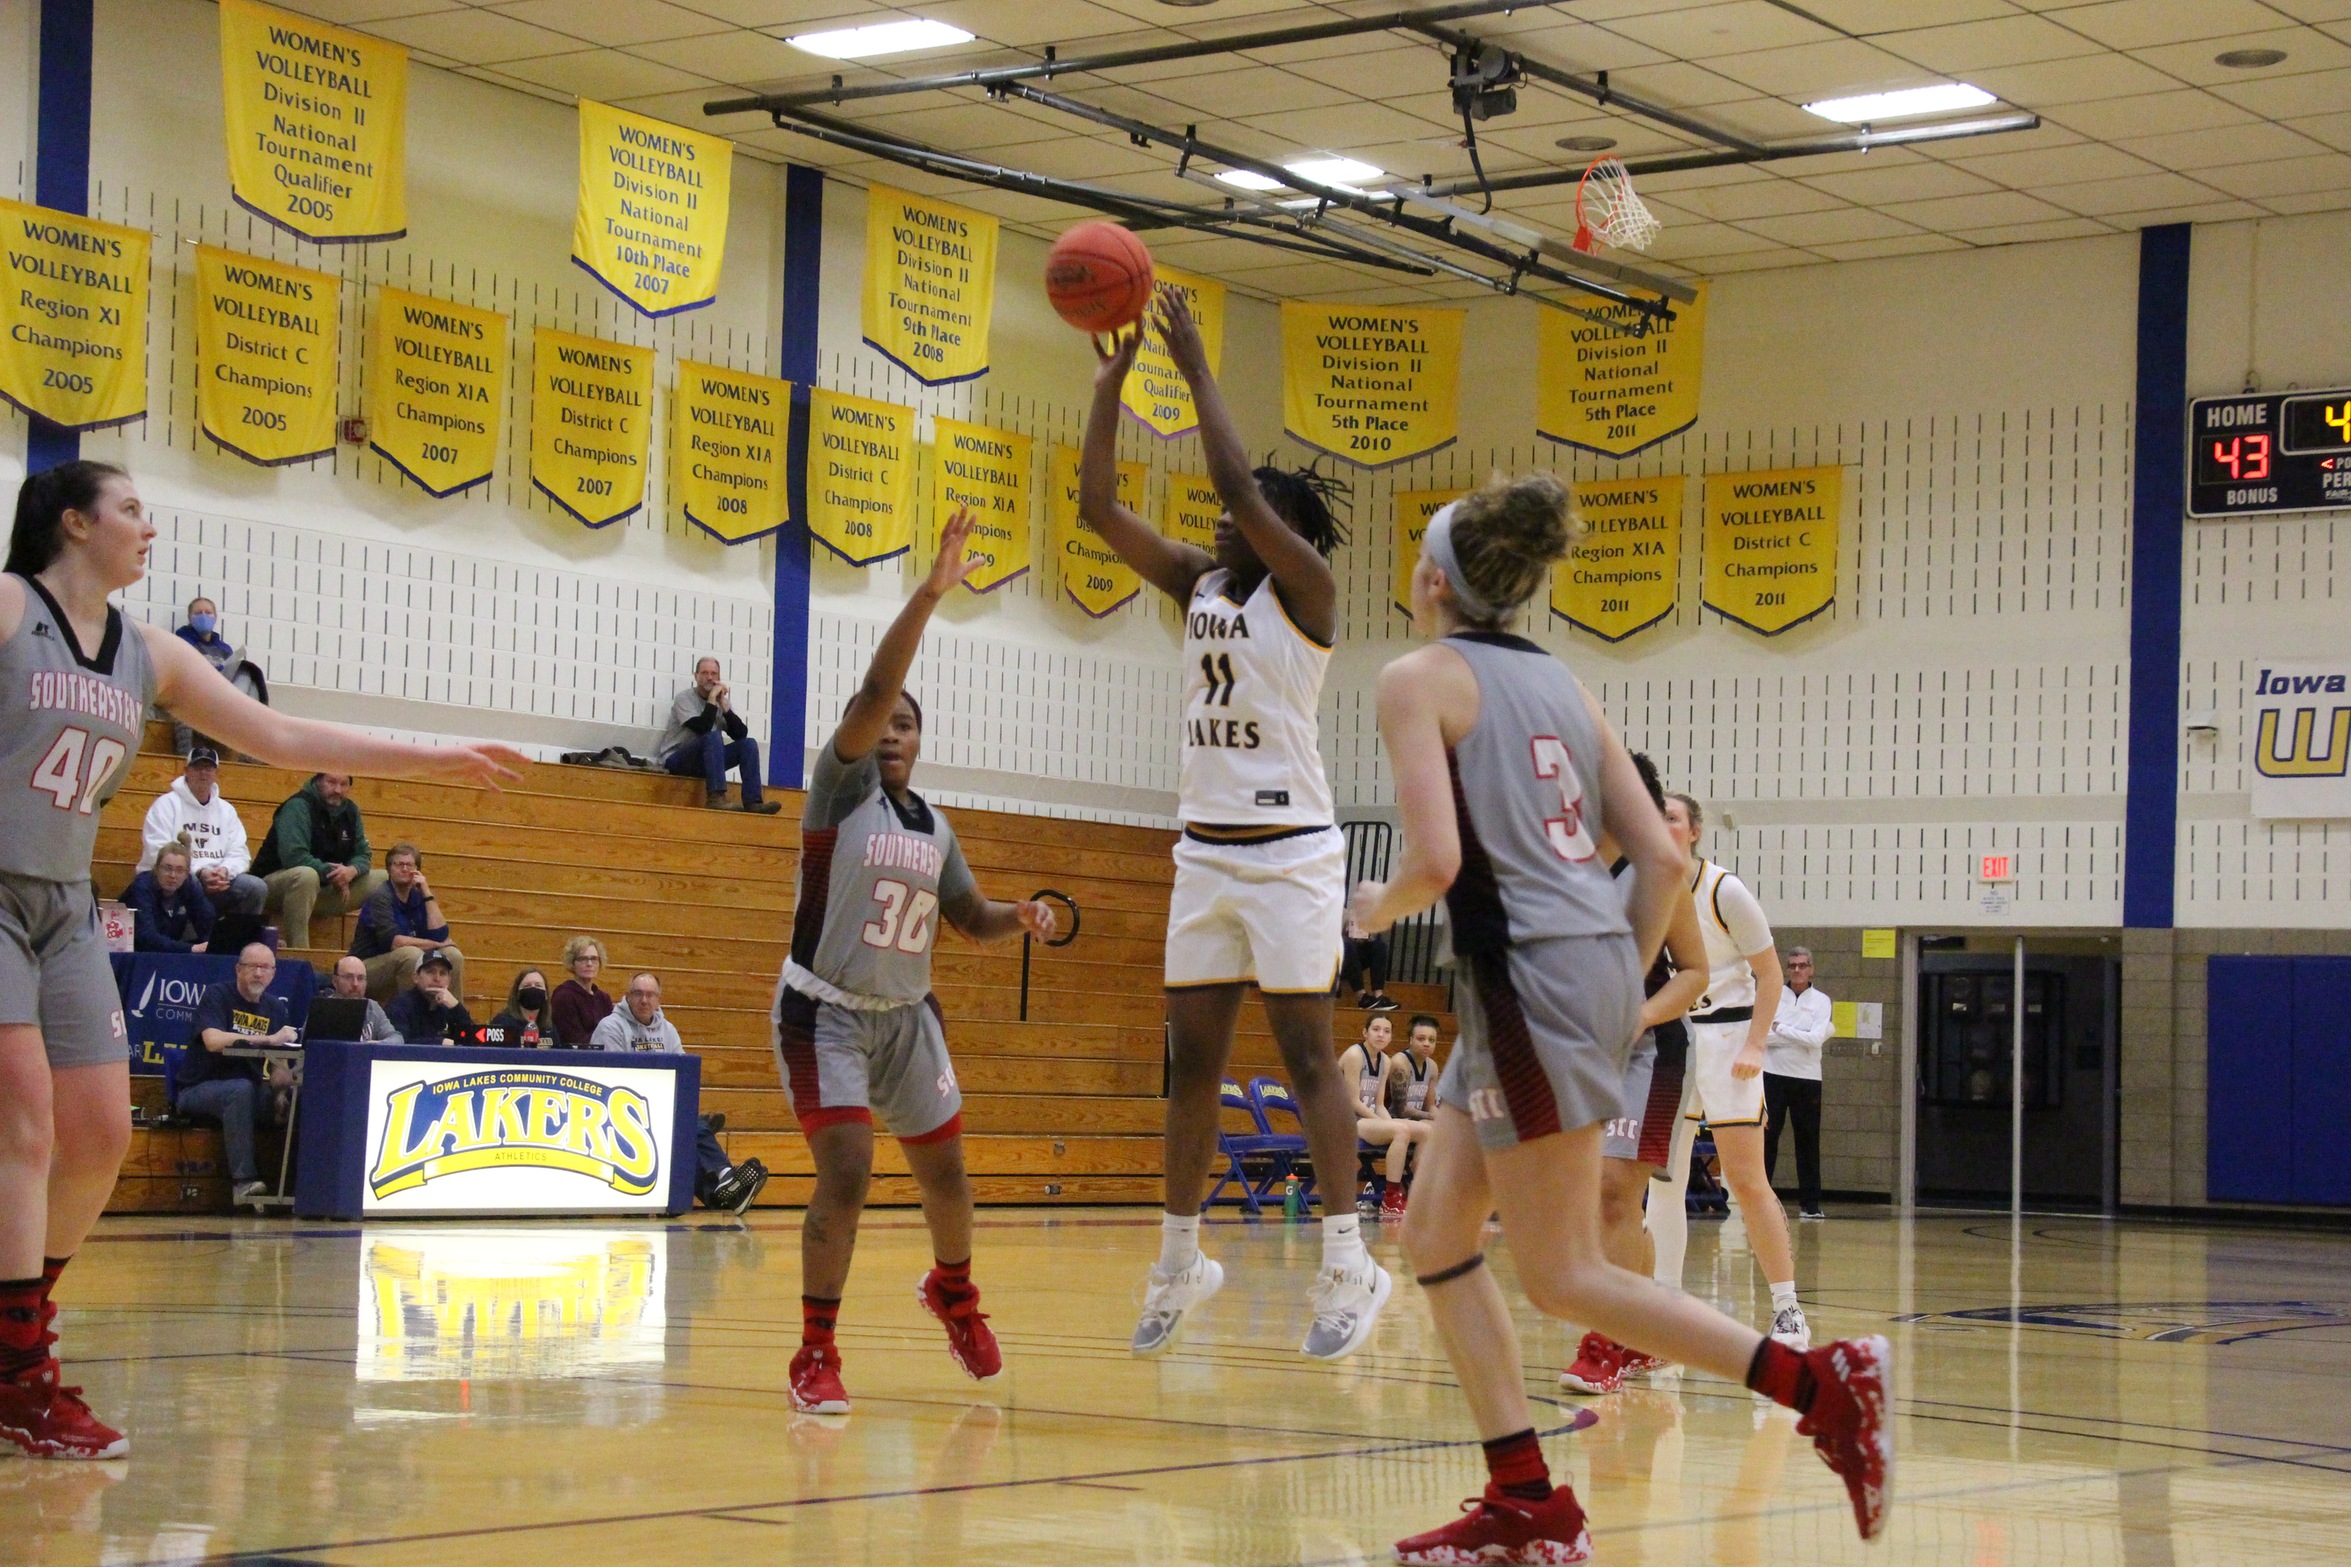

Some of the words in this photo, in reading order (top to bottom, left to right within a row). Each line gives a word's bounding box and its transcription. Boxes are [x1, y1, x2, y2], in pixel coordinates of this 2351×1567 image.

[269, 26, 360, 67] WOMEN'S
[256, 51, 371, 98] VOLLEYBALL
[264, 82, 341, 119] Division
[355, 107, 364, 125] II
[274, 114, 355, 151] National
[619, 125, 694, 160] WOMEN'S
[256, 133, 372, 177] Tournament
[610, 146, 702, 188] VOLLEYBALL
[274, 164, 352, 198] Qualifier
[614, 172, 678, 204] Division
[688, 193, 696, 209] II
[287, 194, 333, 221] 2005
[621, 199, 687, 231] National
[903, 205, 967, 237] WOMEN'S
[23, 220, 121, 258] WOMEN'S
[606, 218, 700, 258] Tournament
[893, 226, 972, 262] VOLLEYBALL
[9, 251, 132, 294] VOLLEYBALL
[618, 246, 648, 267] 10th
[654, 254, 689, 277] Place
[898, 250, 952, 278] Division
[960, 268, 968, 282] II
[224, 265, 312, 301] WOMEN'S
[635, 273, 668, 294] 2007
[905, 273, 960, 302] National
[21, 290, 88, 320] Region
[99, 306, 119, 325] XI
[214, 295, 319, 335] VOLLEYBALL
[889, 292, 971, 326] Tournament
[404, 306, 483, 340] WOMEN'S
[903, 317, 926, 336] 9th
[931, 325, 960, 346] Place
[1329, 316, 1418, 333] WOMEN'S
[12, 325, 122, 360] Champions
[227, 332, 287, 360] District
[296, 348, 307, 364] C
[395, 336, 493, 373] VOLLEYBALL
[913, 342, 943, 362] 2008
[1316, 335, 1429, 353] VOLLEYBALL
[1578, 345, 1646, 362] Division
[1657, 339, 1666, 353] II
[558, 347, 631, 374] WOMEN'S
[1323, 355, 1398, 371] Division
[1411, 359, 1421, 372] II
[1585, 361, 1658, 381] National
[43, 369, 93, 394] 2005
[215, 364, 311, 398] Champions
[396, 369, 449, 395] Region
[550, 376, 641, 406] VOLLEYBALL
[702, 379, 770, 405] WOMEN'S
[1144, 378, 1191, 403] Qualifier
[1332, 375, 1412, 391] National
[1570, 381, 1672, 403] Tournament
[1153, 403, 1180, 420] 2009
[1315, 394, 1428, 412] Tournament
[1586, 407, 1610, 421] 5th
[1616, 404, 1656, 418] Place
[2207, 403, 2267, 428] HOME
[242, 407, 286, 431] 2005
[397, 402, 485, 434] Champions
[561, 407, 613, 431] District
[620, 418, 628, 433] C
[691, 406, 774, 436] VOLLEYBALL
[832, 405, 895, 431] WOMEN'S
[1332, 415, 1359, 429] 5th
[1366, 416, 1408, 431] Place
[2325, 401, 2351, 443] 4
[1350, 435, 1391, 451] 2010
[1607, 424, 1635, 439] 2011
[422, 443, 458, 464] 2007
[554, 438, 637, 465] Champions
[691, 435, 740, 457] Region
[823, 433, 899, 460] VOLLEYBALL
[954, 435, 1012, 459] WOMEN'S
[2214, 434, 2269, 480] 43
[829, 462, 872, 482] District
[881, 471, 888, 484] C
[945, 460, 1018, 488] VOLLEYBALL
[2336, 456, 2351, 470] PO
[577, 477, 612, 496] 2007
[693, 464, 767, 490] Champions
[1734, 480, 1815, 498] WOMEN'S
[2323, 472, 2351, 489] PER
[717, 496, 747, 514] 2008
[825, 490, 892, 514] Champions
[946, 487, 985, 507] Region
[1579, 490, 1658, 507] WOMEN'S
[2227, 487, 2278, 505] BONUS
[845, 520, 872, 537] 2008
[1179, 512, 1217, 541] VOLLEY
[1721, 506, 1825, 526] VOLLEYBALL
[969, 520, 1012, 540] mpions
[1734, 536, 1790, 550] District
[1799, 533, 1810, 546] C
[1066, 540, 1126, 565] Champio
[1572, 546, 1624, 562] Region
[1086, 575, 1113, 592] 2009
[1574, 570, 1661, 586] Champions
[1725, 562, 1817, 579] Champions
[1601, 599, 1628, 612] 2011
[1755, 593, 1785, 606] 2011
[1189, 612, 1251, 640] IOWA
[1201, 653, 1235, 706] 11
[2255, 669, 2346, 696] Iowa
[30, 725, 127, 816] 40
[1530, 735, 1597, 863] 3
[183, 822, 221, 836] MSU
[192, 848, 226, 860] SEBALL
[1983, 857, 2008, 878] EXIT
[862, 878, 938, 954] 30
[159, 978, 206, 1006] IOW
[486, 1027, 505, 1043] POSS
[432, 1081, 460, 1095] IOWA
[463, 1074, 496, 1088] LAKES
[500, 1073, 557, 1085] COMMUNITY
[560, 1076, 603, 1097] COLLEGE
[371, 1084, 656, 1182] LAKERS
[494, 1151, 547, 1162] ATHLETICS
[1285, 1185, 1294, 1196] G
